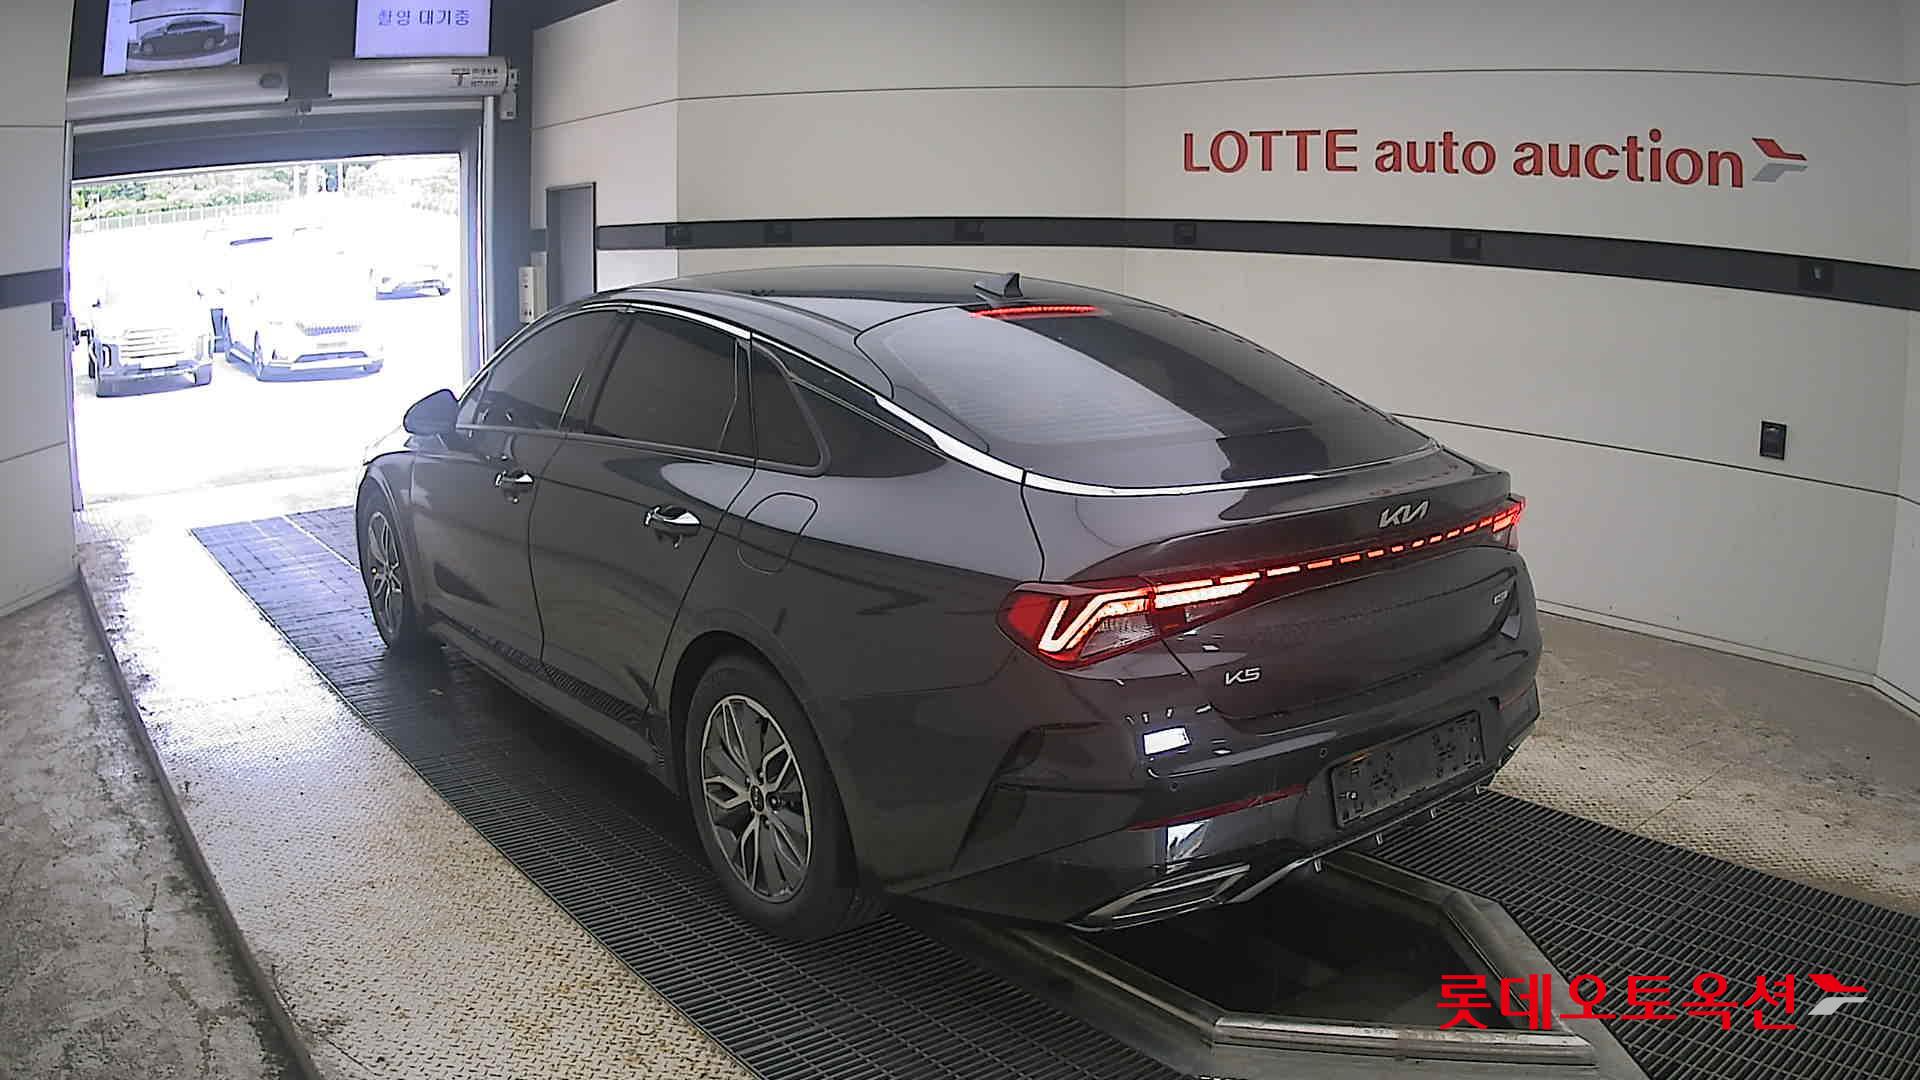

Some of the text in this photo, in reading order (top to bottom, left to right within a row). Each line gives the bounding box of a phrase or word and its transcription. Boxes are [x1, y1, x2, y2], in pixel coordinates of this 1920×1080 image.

[419, 9, 470, 26] 대기중
[1183, 128, 1744, 189] LOTTE auto auction
[1225, 667, 1261, 685] K5
